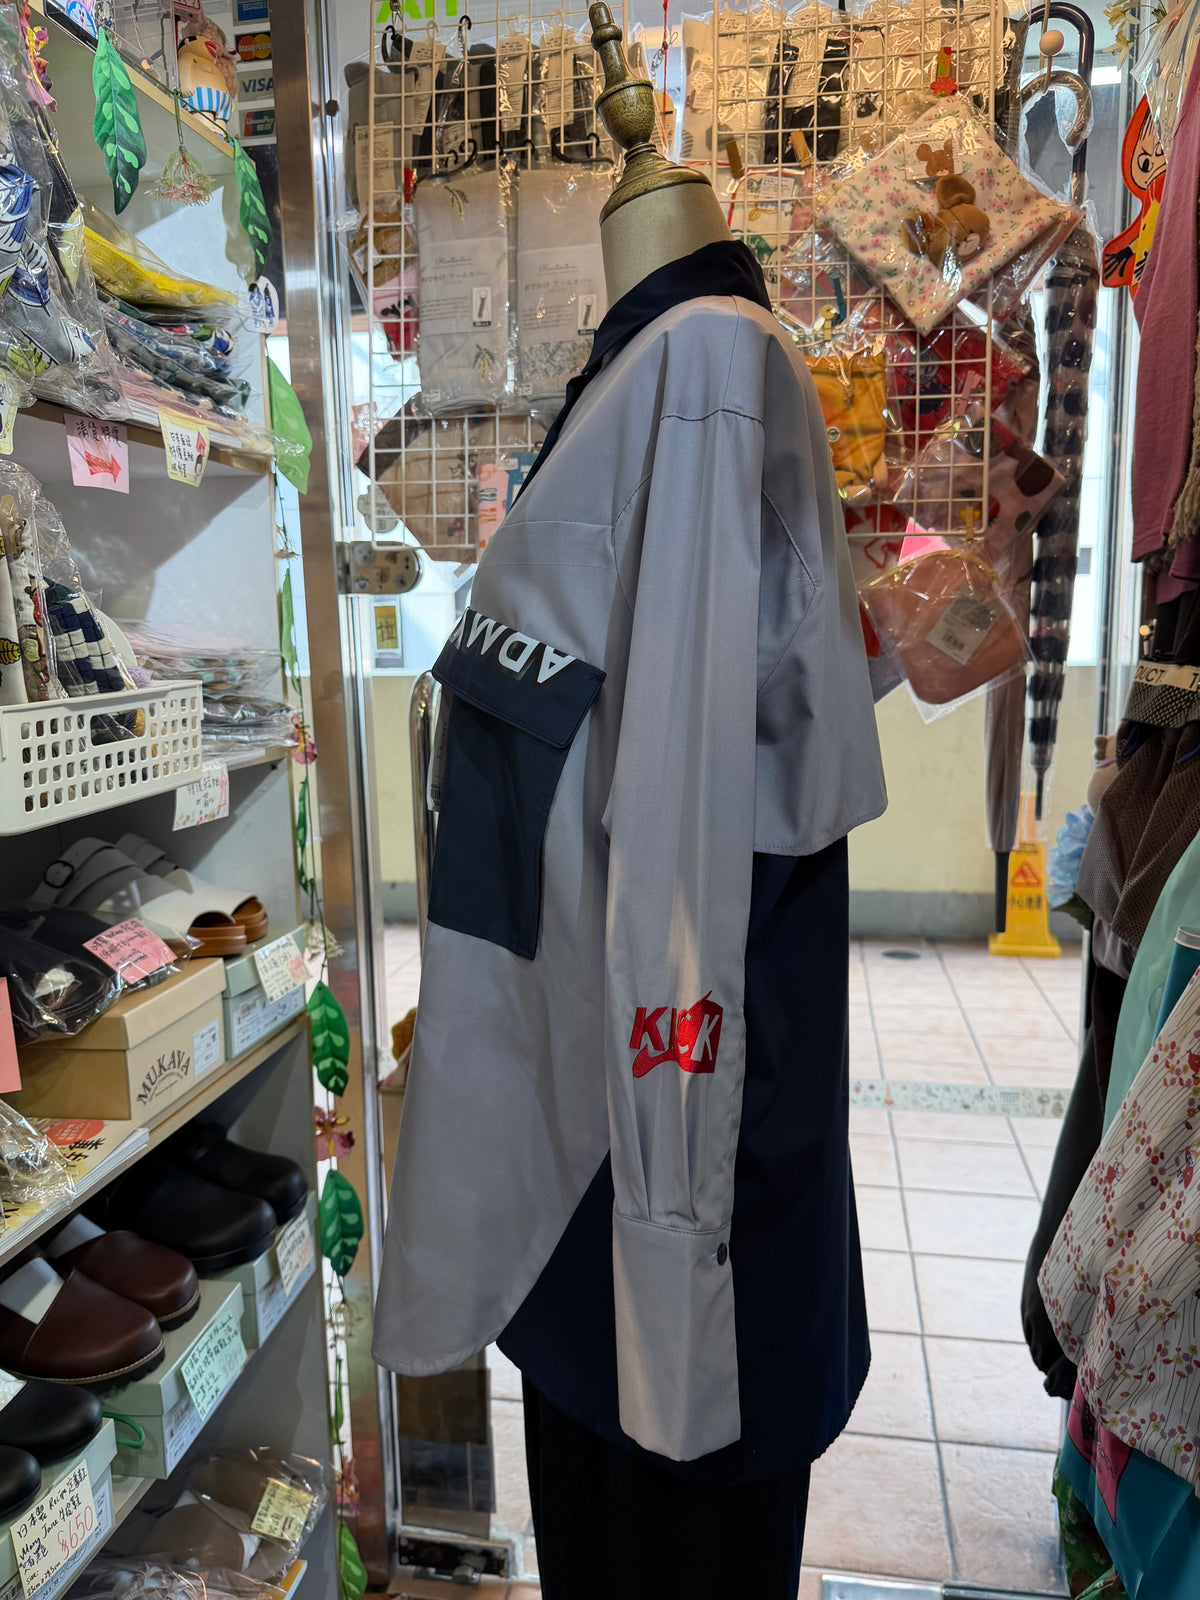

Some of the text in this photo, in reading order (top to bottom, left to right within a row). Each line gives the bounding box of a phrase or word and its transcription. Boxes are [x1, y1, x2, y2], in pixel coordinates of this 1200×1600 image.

[243, 77, 273, 93] VISA
[136, 1049, 191, 1106] MUKAVA
[19, 1537, 41, 1560] Mary
[41, 1519, 59, 1539] Jane
[56, 1505, 94, 1561] $650
